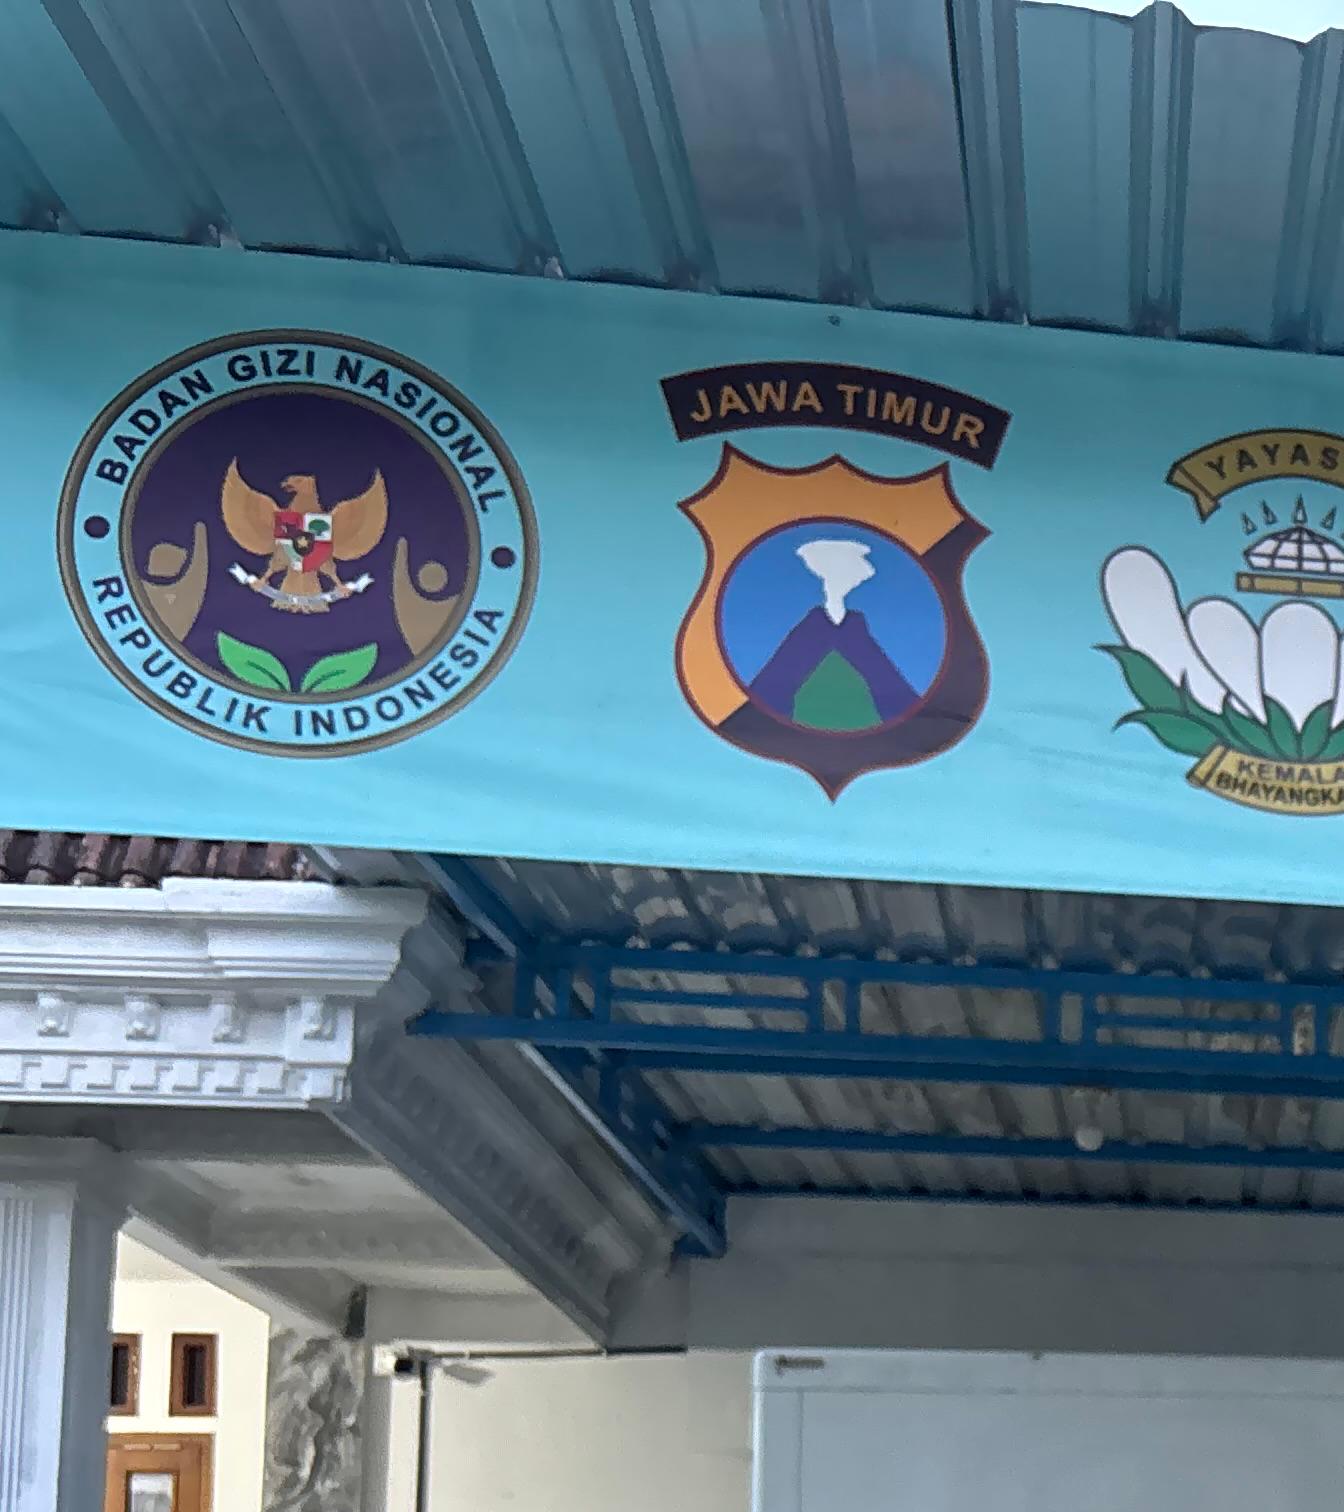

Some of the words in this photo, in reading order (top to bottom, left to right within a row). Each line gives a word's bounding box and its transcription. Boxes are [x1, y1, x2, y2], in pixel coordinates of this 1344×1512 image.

[95, 370, 213, 486] BADAN
[227, 349, 314, 382] GIZI
[336, 356, 506, 513] NASIONAL
[690, 380, 823, 422] JAWA
[836, 384, 986, 449] TIMUR
[93, 574, 271, 733] REPUBLIK
[294, 607, 504, 736] INDONESIA
